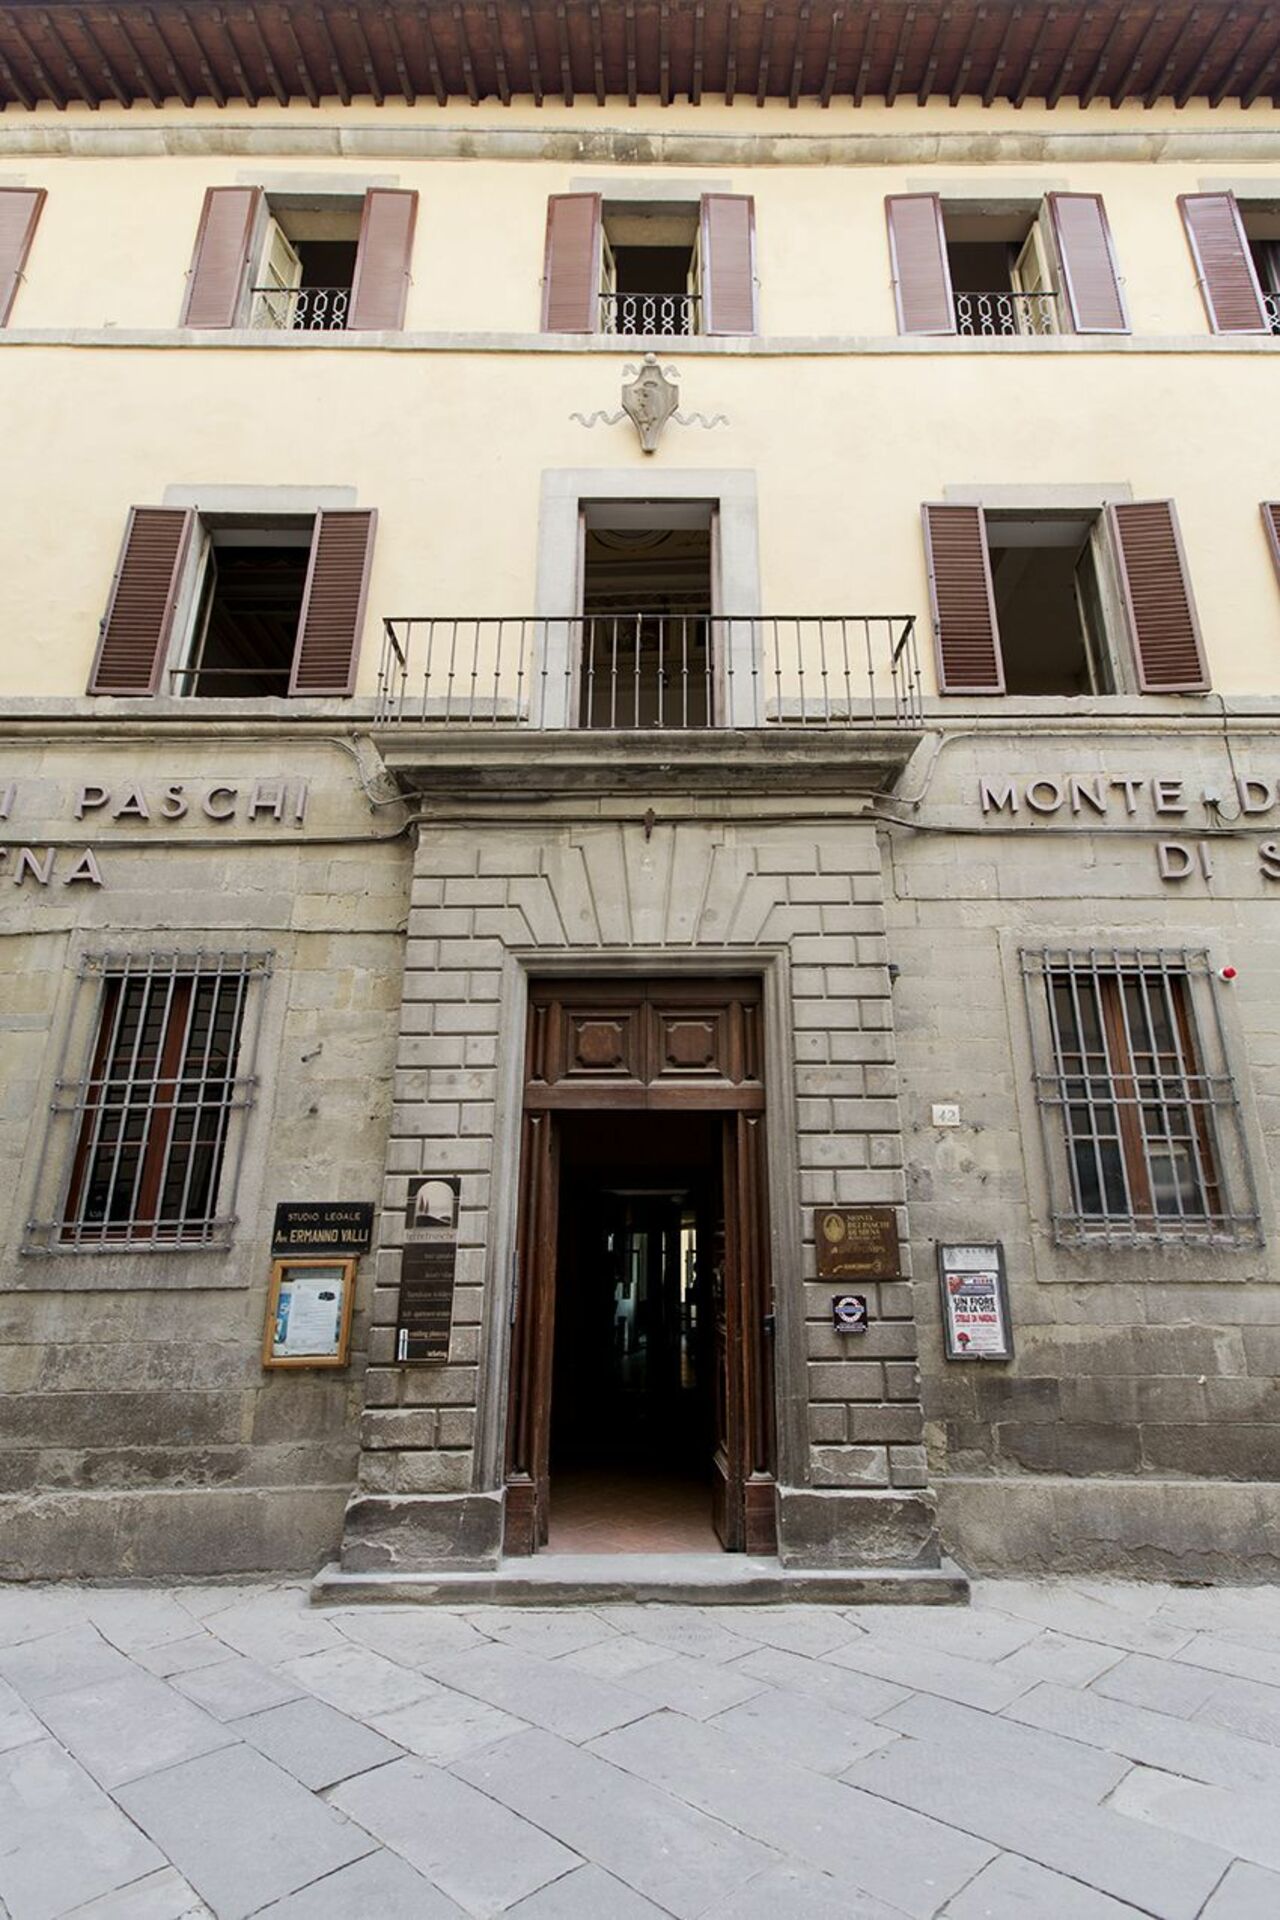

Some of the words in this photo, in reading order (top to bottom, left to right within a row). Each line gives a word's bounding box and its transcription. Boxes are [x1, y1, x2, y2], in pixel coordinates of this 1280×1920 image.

[74, 783, 309, 822] PASCHI
[978, 777, 1189, 815] MONTE
[1238, 777, 1280, 815] D
[0, 847, 105, 887] NA
[1156, 840, 1214, 881] DI
[288, 1212, 320, 1221] STUDIO
[324, 1211, 361, 1221] LEGALE
[289, 1228, 339, 1243] ERMANNO
[340, 1228, 369, 1242] VALLI
[954, 1305, 968, 1313] PER
[970, 1297, 995, 1305] FIORE
